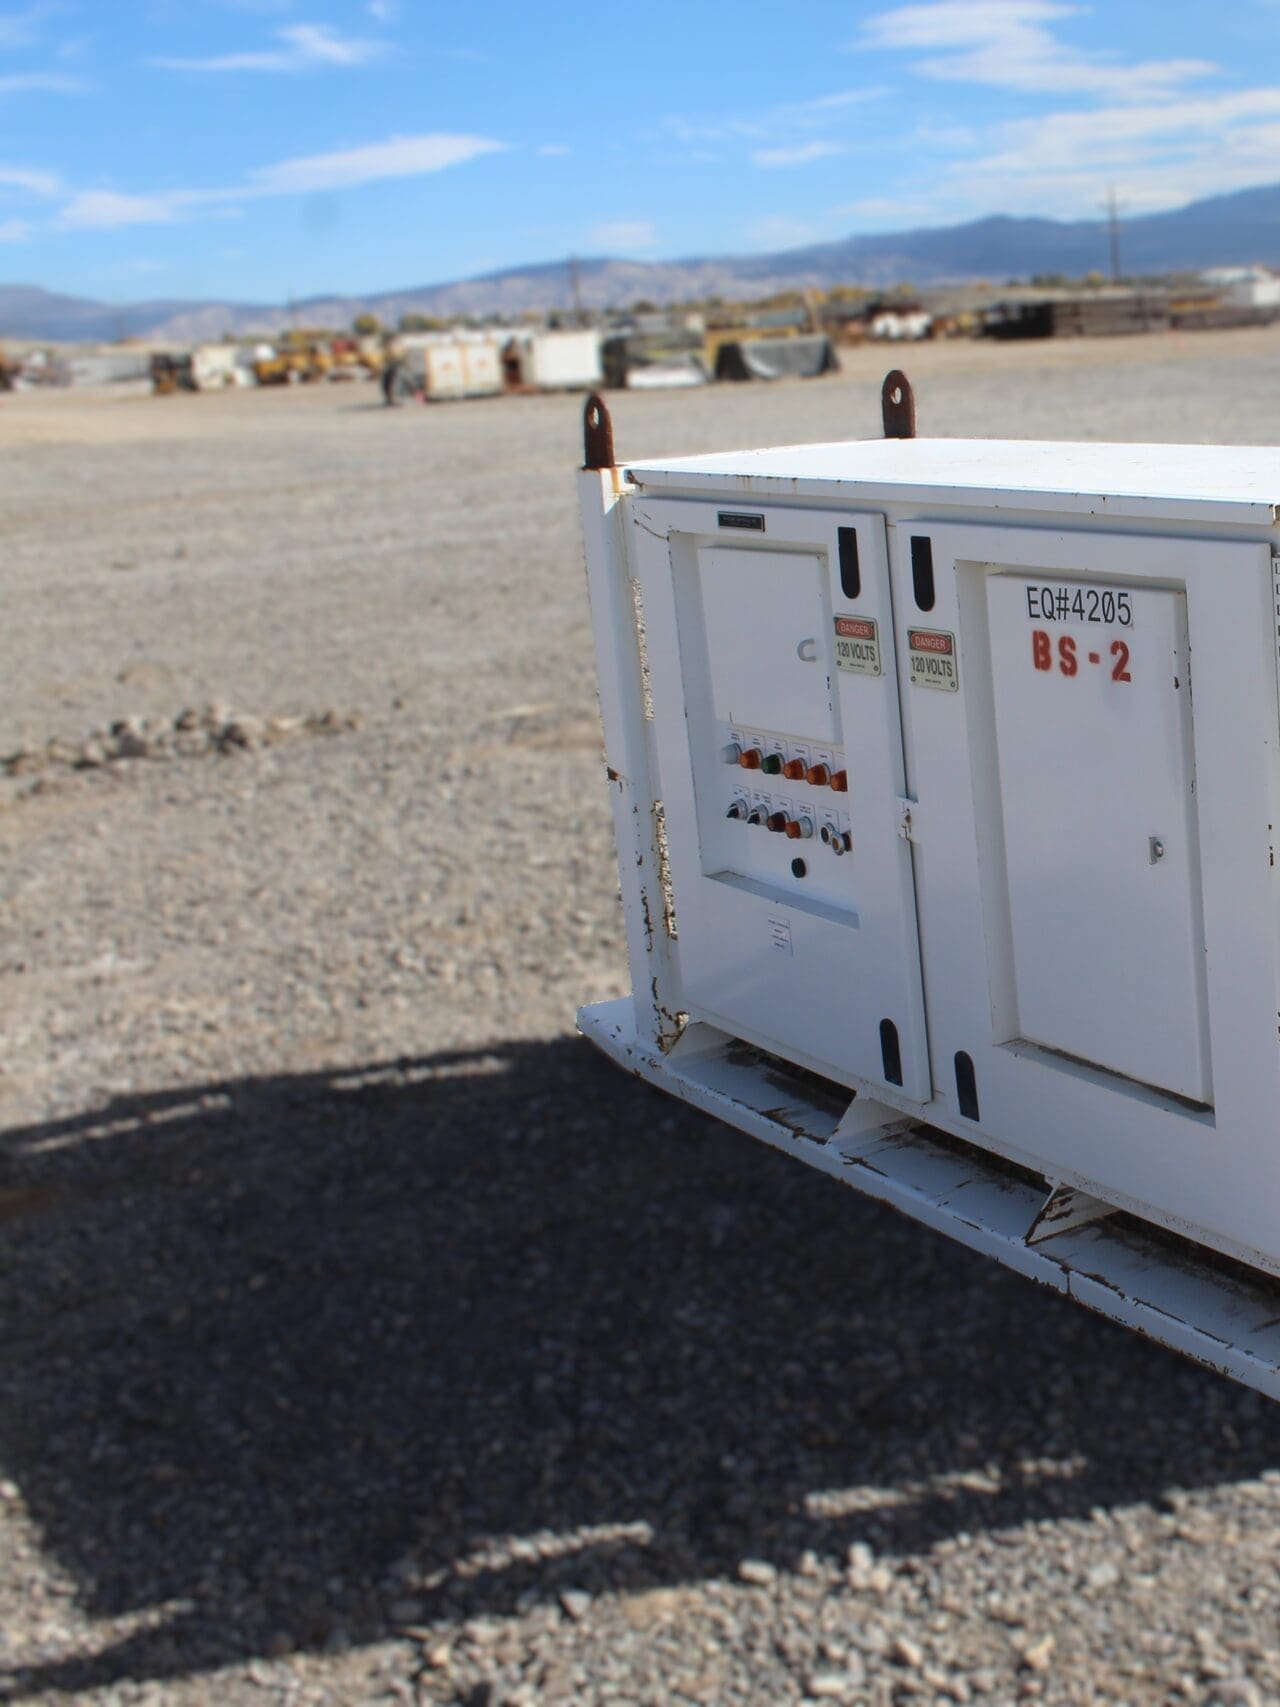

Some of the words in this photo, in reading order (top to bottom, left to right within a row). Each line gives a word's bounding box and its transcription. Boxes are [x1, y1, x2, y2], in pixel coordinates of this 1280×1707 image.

[1026, 586, 1132, 626] EQ#4205
[840, 622, 869, 636] DANGER
[837, 642, 849, 658] 120
[851, 643, 875, 662] VOLTS
[914, 635, 946, 650] DANGER
[911, 656, 925, 673] 120
[926, 659, 953, 678] VOLTS
[1032, 630, 1132, 683] BS-2
